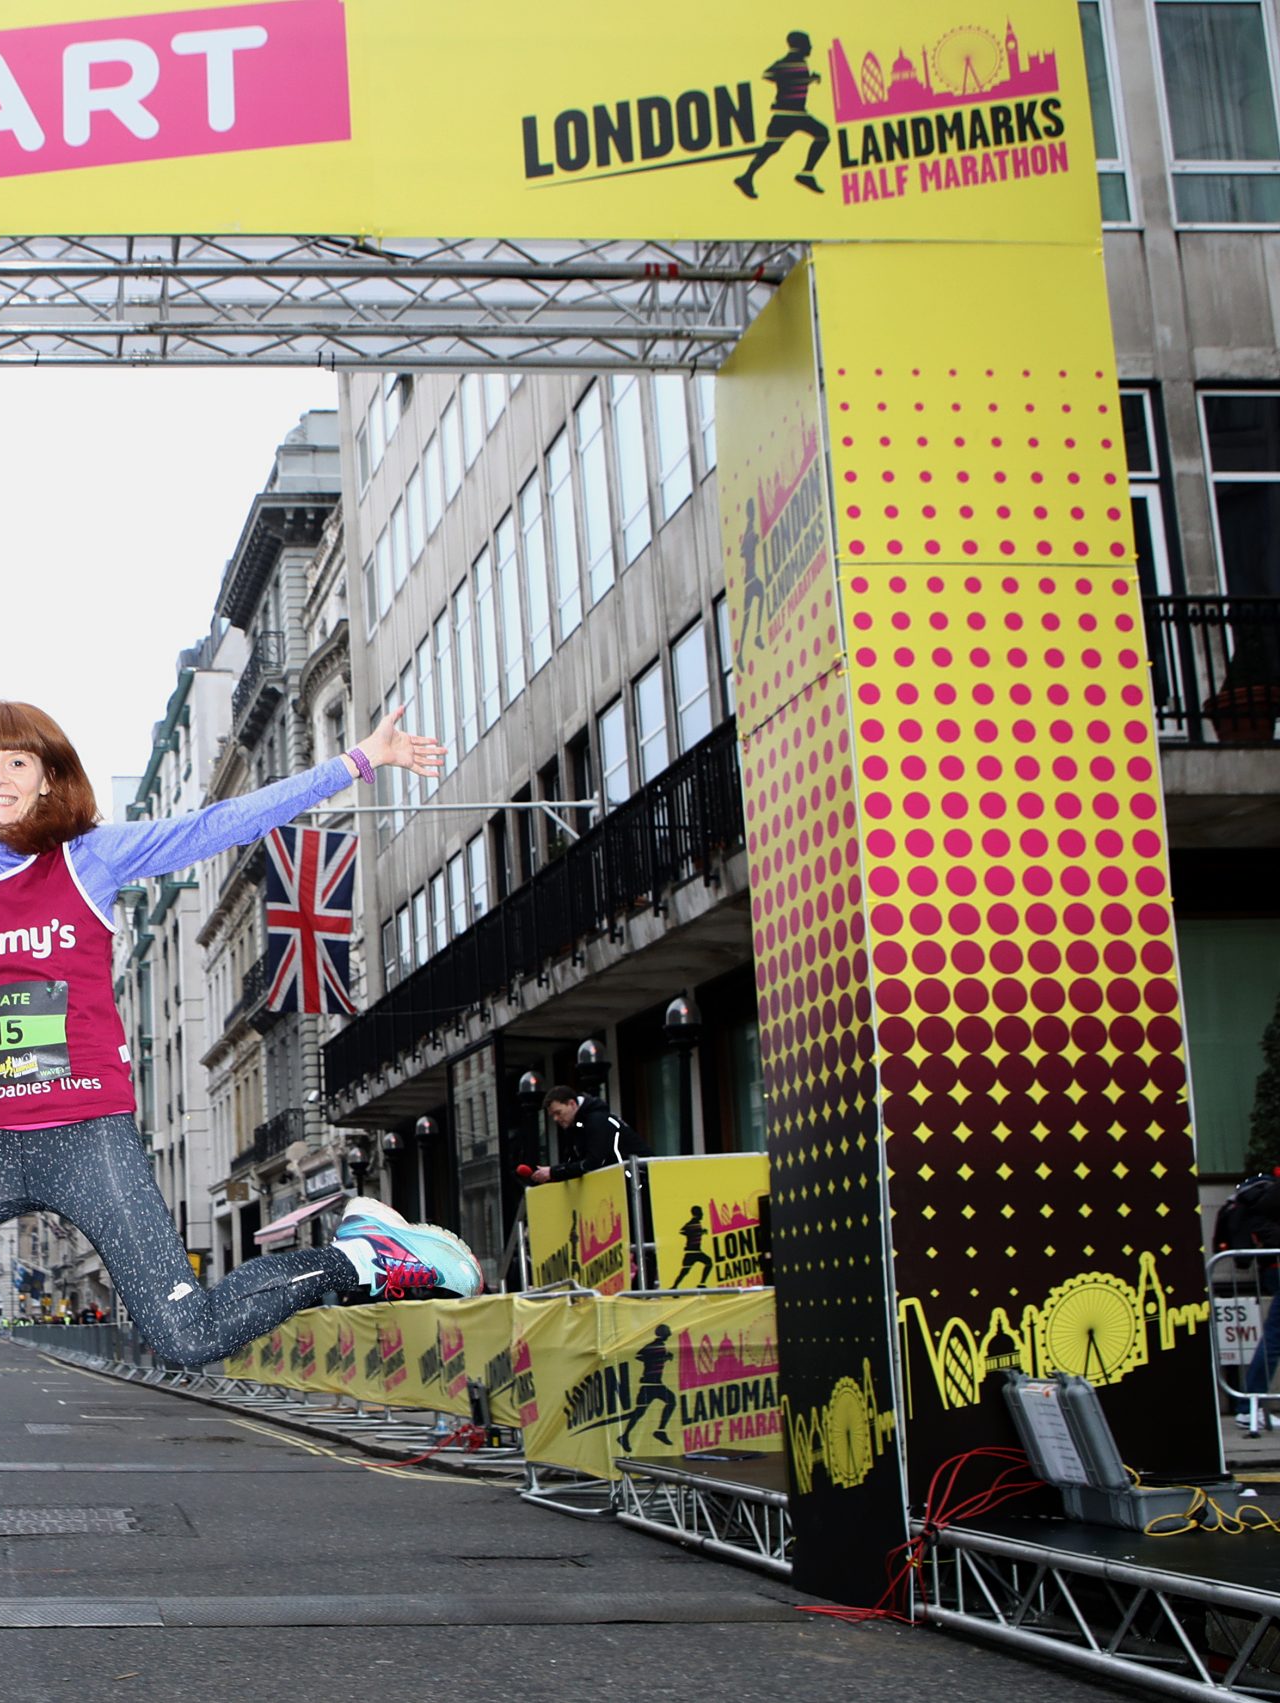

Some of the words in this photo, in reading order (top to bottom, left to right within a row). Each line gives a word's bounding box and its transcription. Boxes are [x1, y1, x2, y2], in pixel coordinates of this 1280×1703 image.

[521, 81, 756, 179] LONDON
[838, 98, 1065, 168] LANDMARKS
[841, 163, 910, 205] HALF
[918, 141, 1070, 194] MARATHON
[763, 459, 822, 590] LONDON
[766, 510, 825, 622] LANDMARKS
[60, 1077, 102, 1091] lives
[712, 1227, 761, 1263] LON
[1225, 1325, 1258, 1343] SW1
[563, 1361, 632, 1431] LONDON
[680, 1376, 781, 1426] LANDMA
[683, 1421, 725, 1454] HALF
